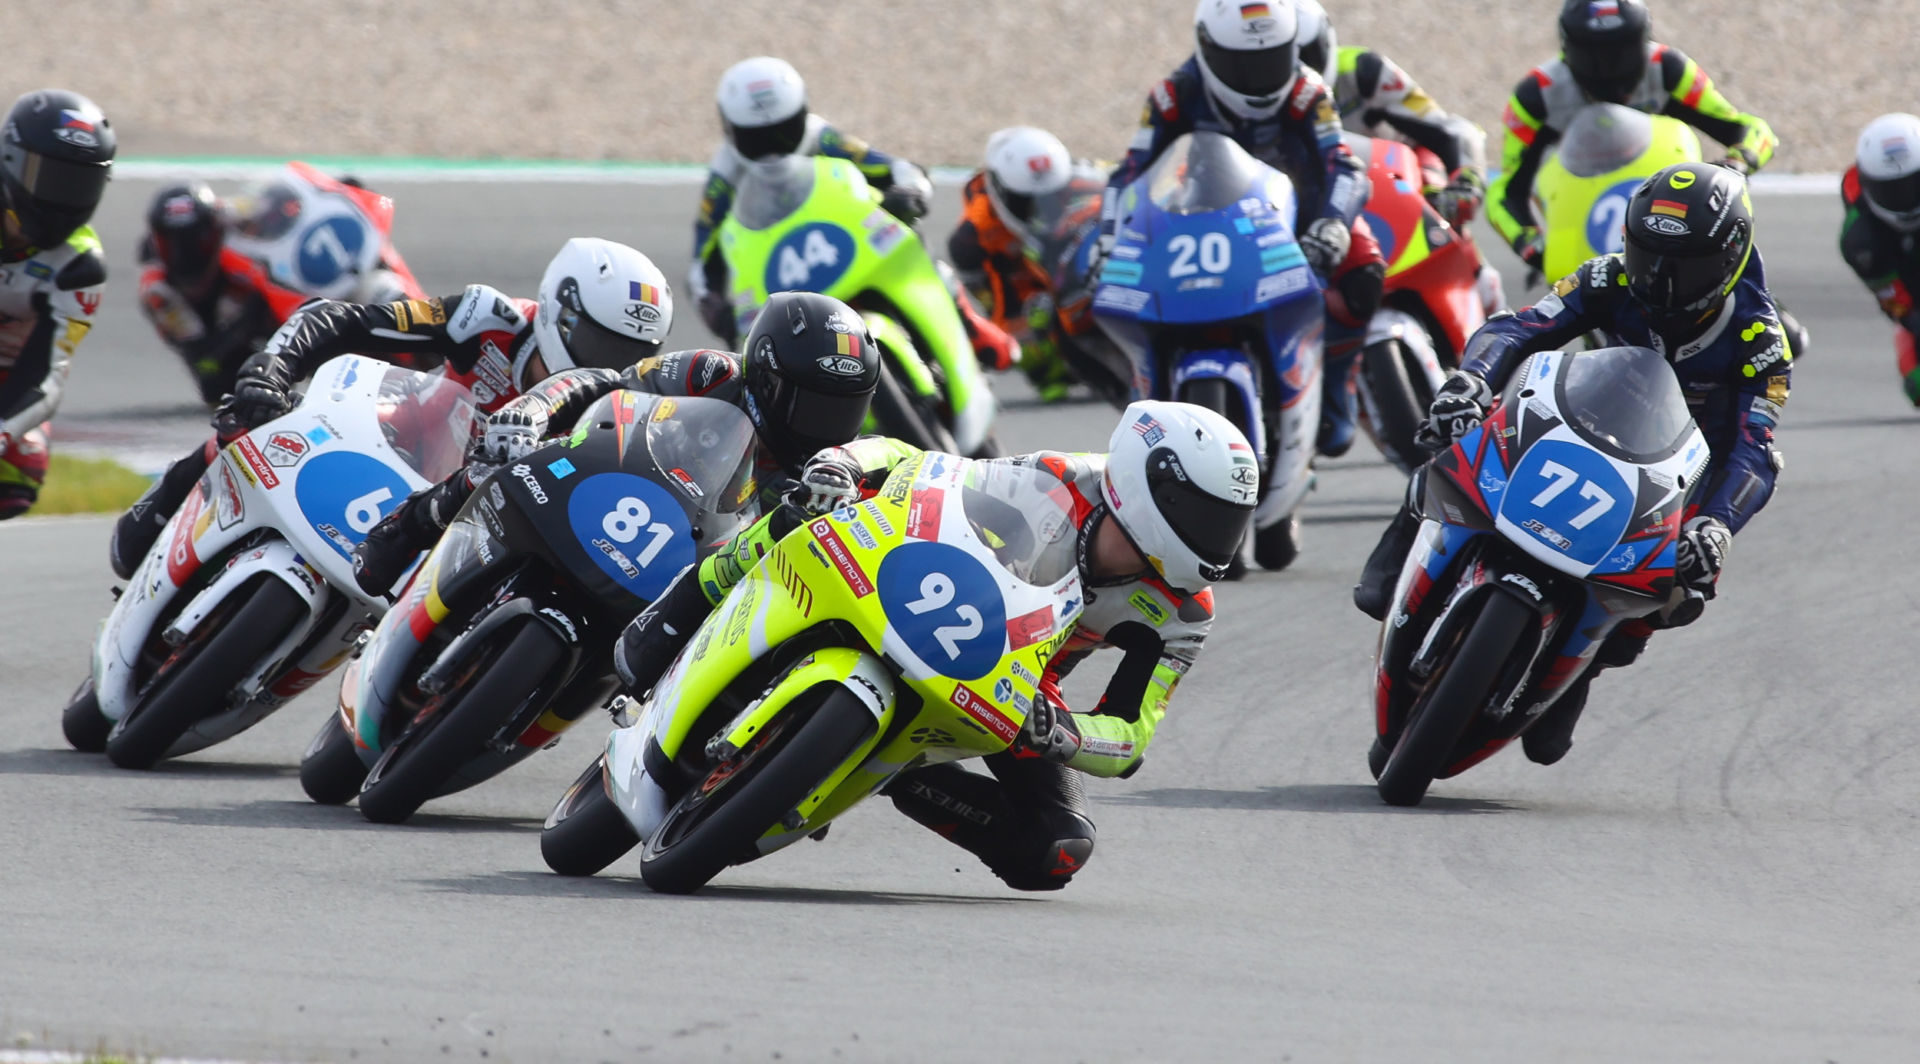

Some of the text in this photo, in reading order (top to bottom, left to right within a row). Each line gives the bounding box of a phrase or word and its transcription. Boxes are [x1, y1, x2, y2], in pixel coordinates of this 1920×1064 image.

[1593, 184, 1643, 253] 2
[307, 225, 349, 269] 7
[778, 229, 840, 288] 44
[1167, 232, 1232, 279] 20
[831, 358, 860, 374] X-lite
[345, 487, 393, 534] 6
[523, 475, 549, 505] CERCO
[1530, 459, 1616, 531] 77
[602, 496, 674, 569] 81
[852, 521, 878, 551] INSERTUS
[287, 566, 316, 596] KTM
[826, 536, 869, 596] RISEMOTO
[1501, 572, 1544, 601] KTM
[539, 606, 579, 643] KTM
[904, 571, 984, 661] 92
[847, 673, 887, 713] KTM
[970, 701, 1016, 739] RISEMOTO
